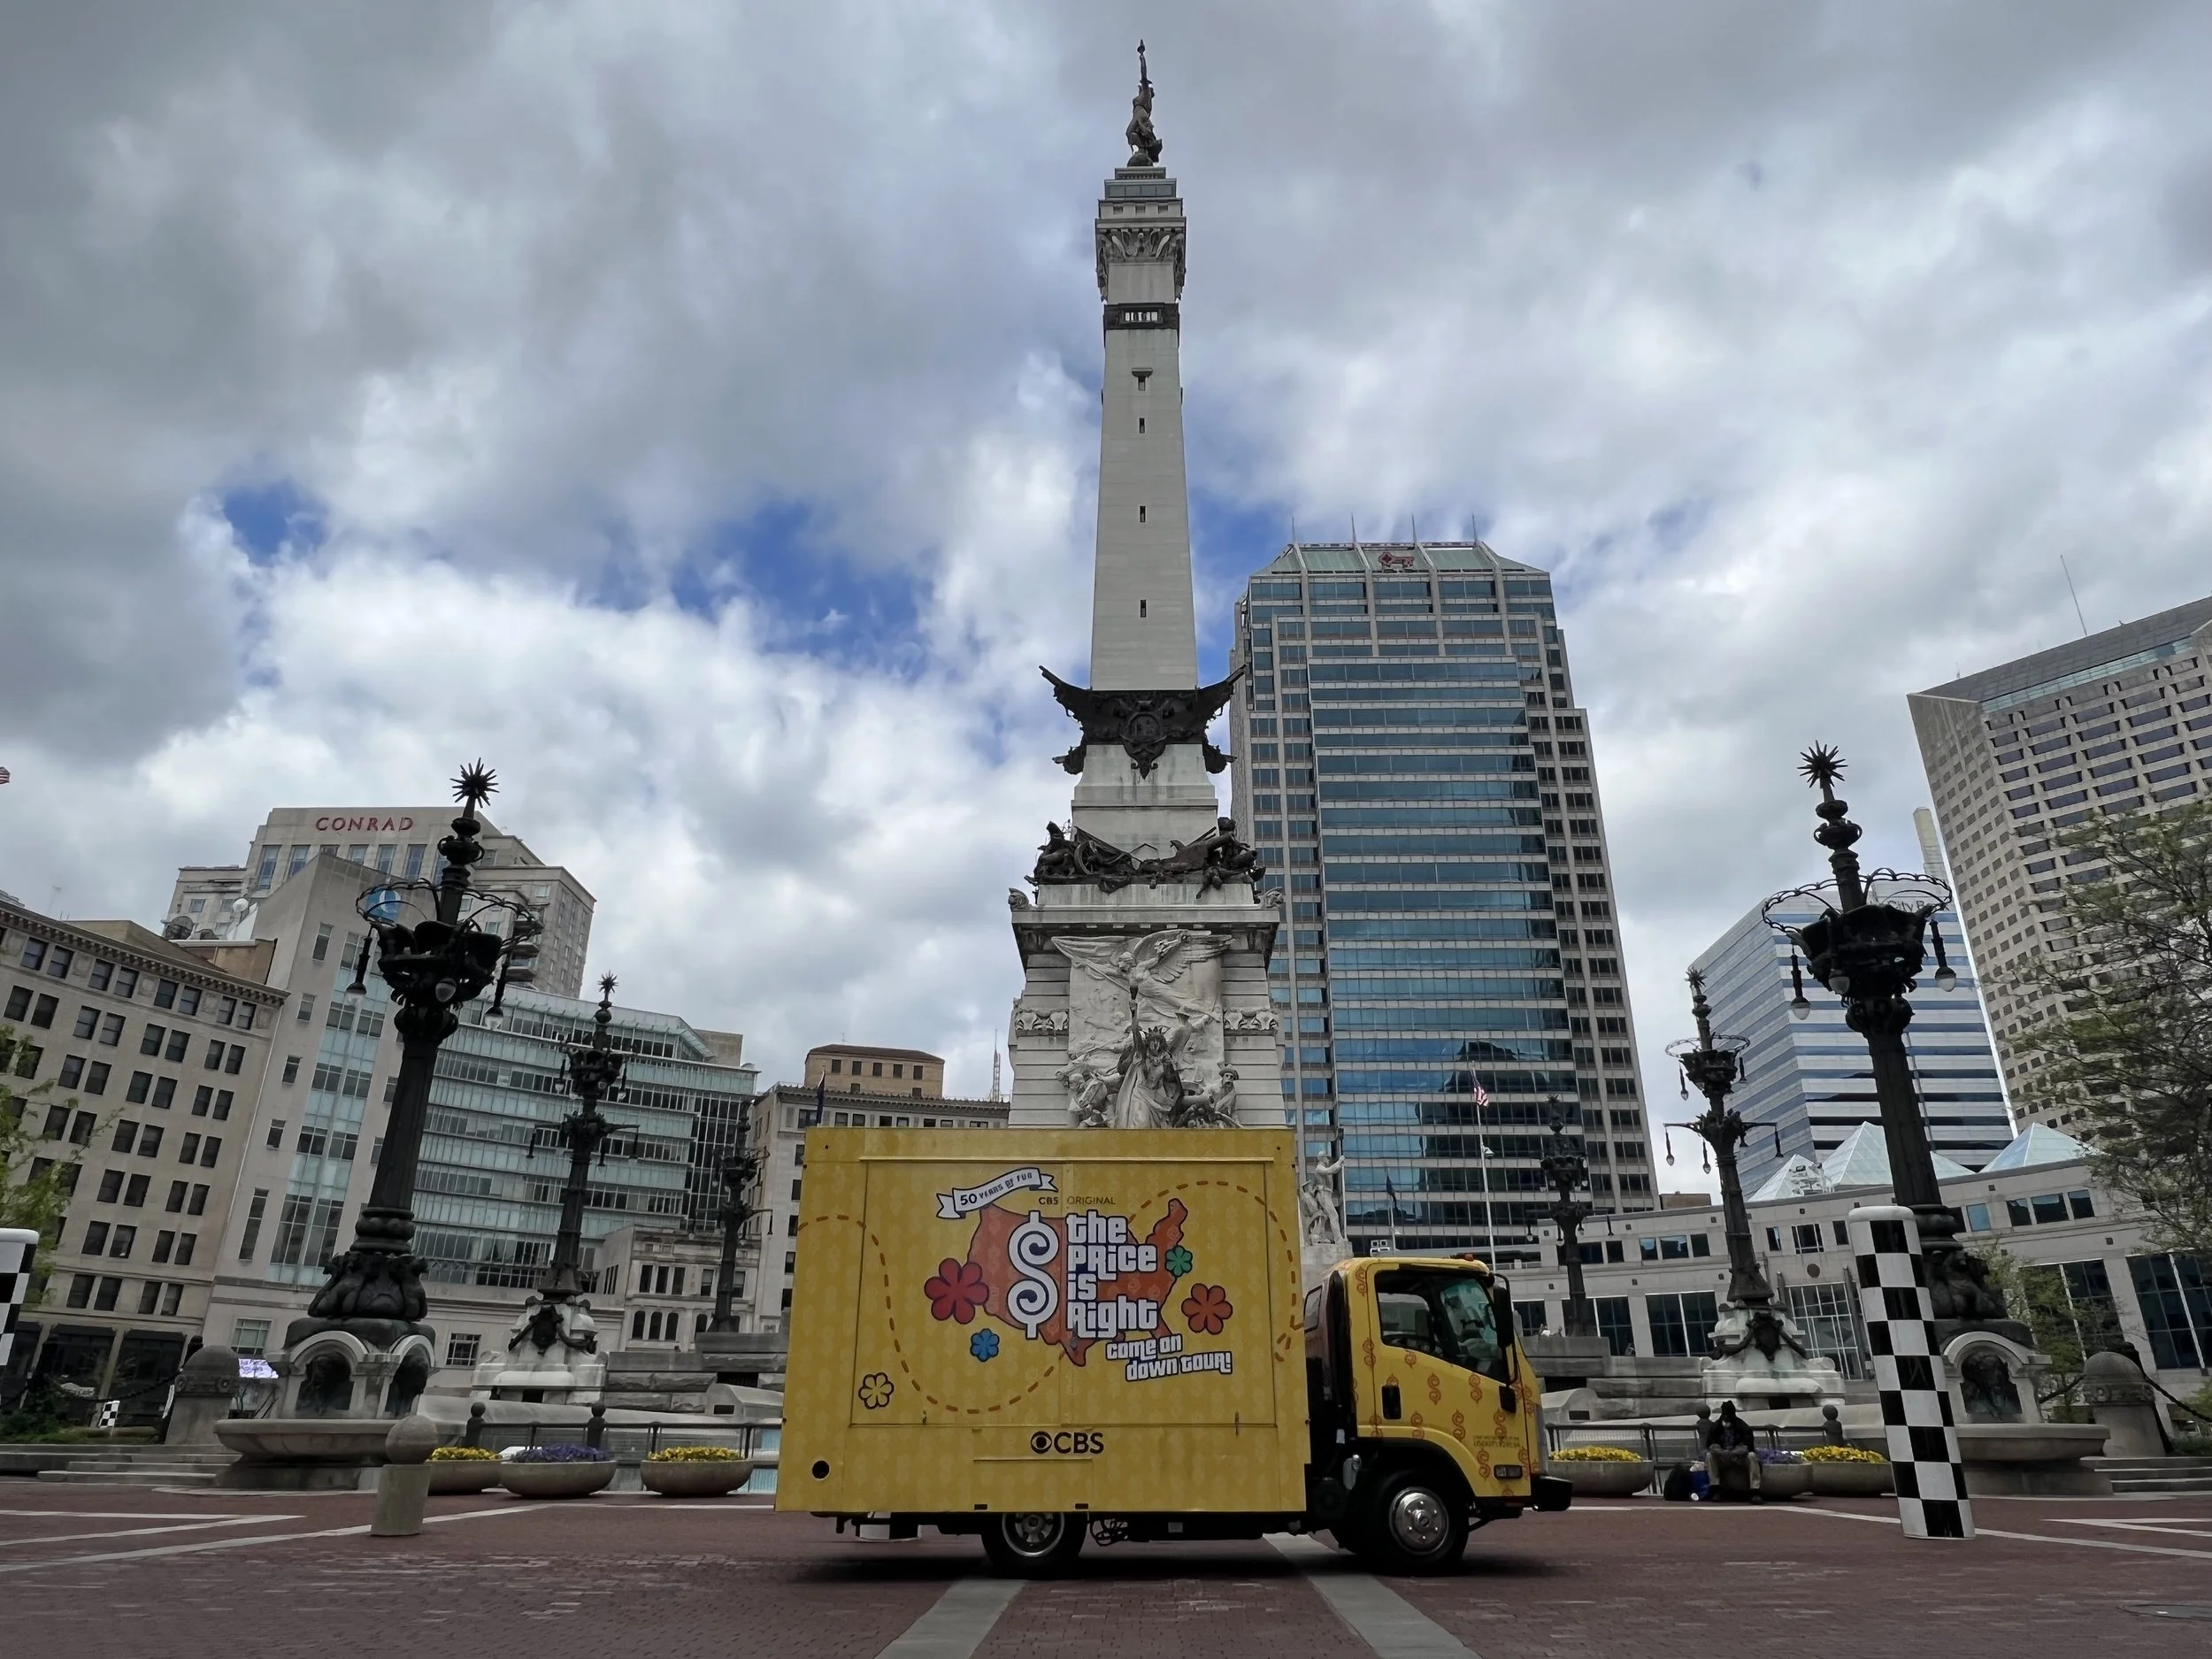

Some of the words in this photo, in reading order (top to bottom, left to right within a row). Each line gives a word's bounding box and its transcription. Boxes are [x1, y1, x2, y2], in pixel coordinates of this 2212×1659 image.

[315, 817, 414, 832] CONRAD
[960, 1193, 978, 1206] 50
[1038, 1196, 1059, 1205] CBS
[1066, 1195, 1118, 1205] ORIGINAL
[1066, 1294, 1158, 1339] Right
[1159, 1334, 1183, 1354] on
[1125, 1356, 1179, 1381] down
[1053, 1431, 1105, 1455] CBS
